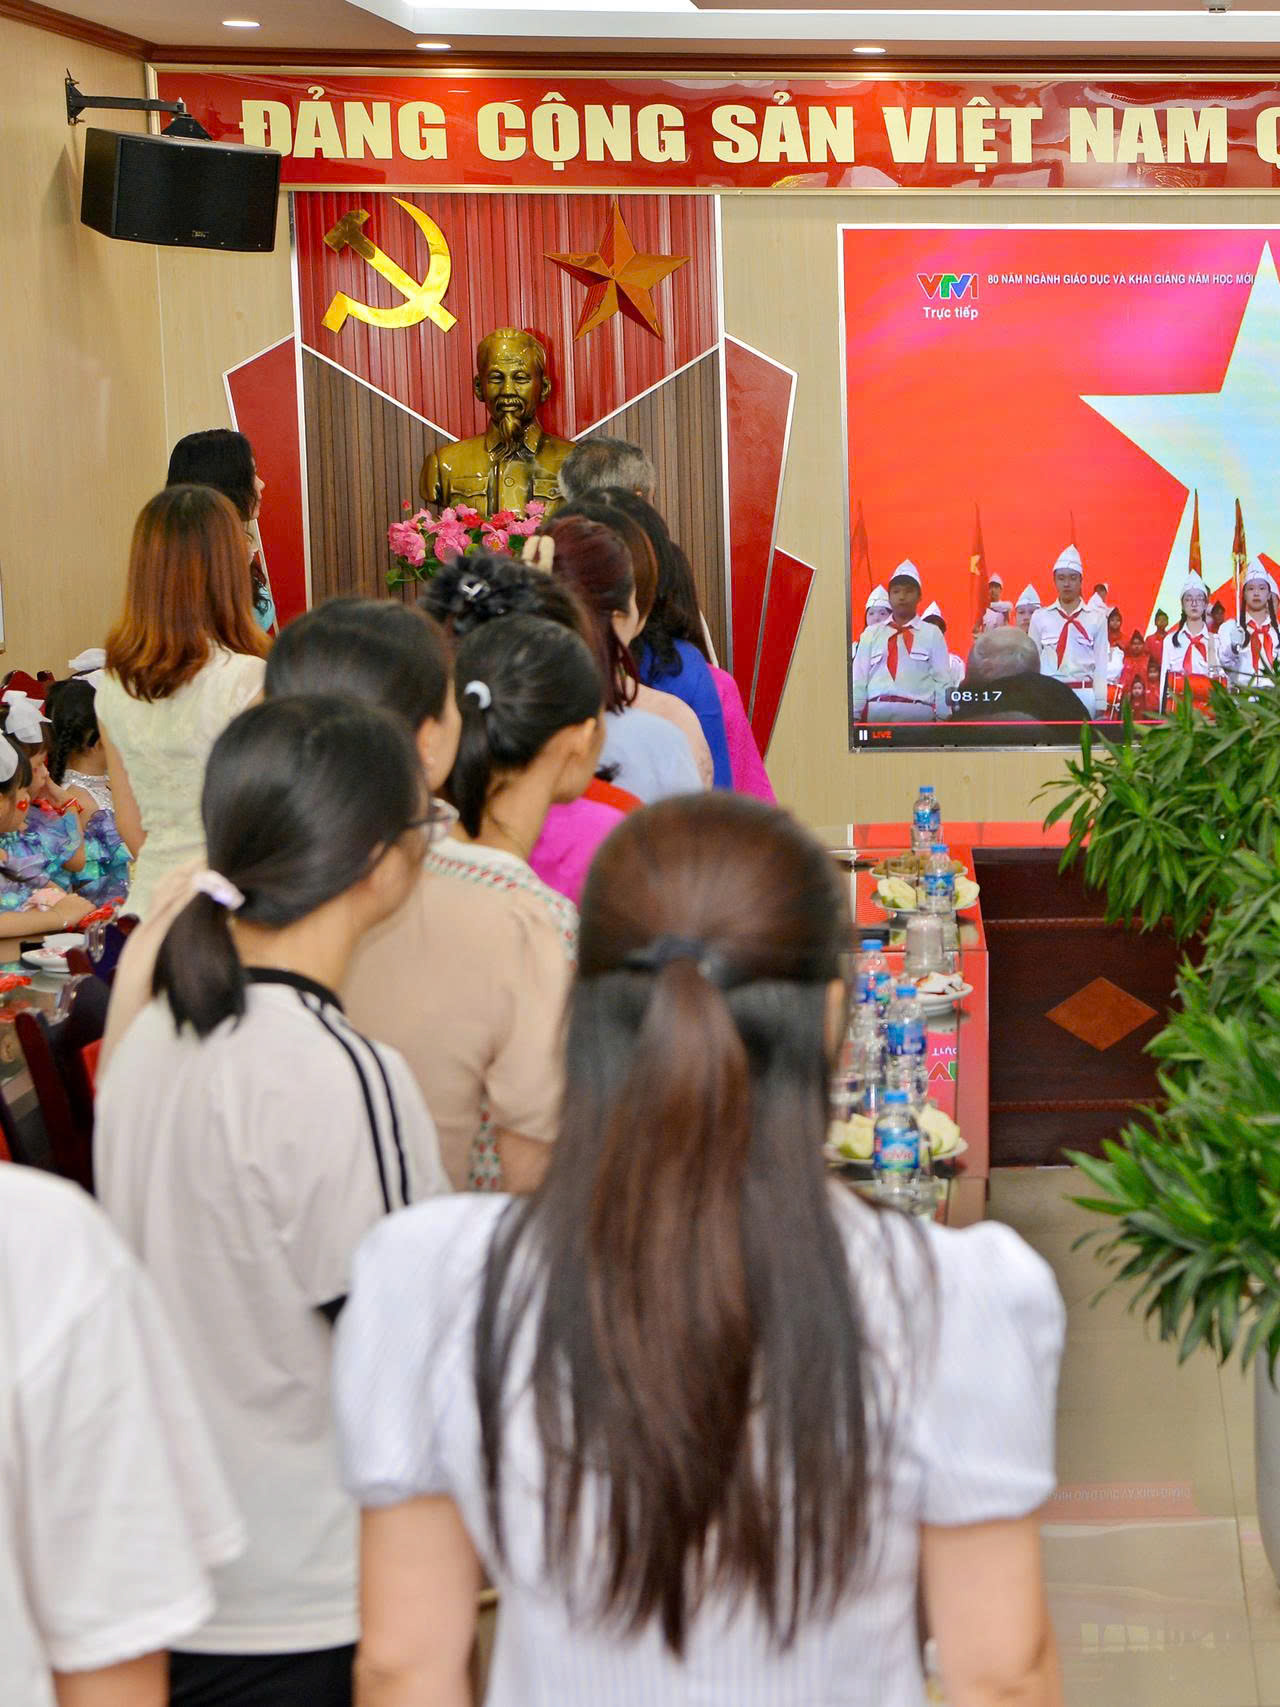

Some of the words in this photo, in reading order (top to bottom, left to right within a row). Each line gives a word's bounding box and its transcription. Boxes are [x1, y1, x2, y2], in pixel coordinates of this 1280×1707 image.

[239, 86, 447, 160] ĐẢNG
[477, 91, 686, 171] CỘNG
[712, 91, 855, 164] SẢN
[882, 96, 1043, 173] VIỆT
[1069, 106, 1228, 164] NAM
[917, 272, 979, 299] VTV1
[987, 274, 999, 285] 80
[1025, 272, 1060, 285] NGÀNH
[1063, 271, 1088, 285] GIÁO
[1090, 273, 1111, 286] DỤC
[1113, 271, 1126, 285] VÀ
[1128, 273, 1152, 285] KHAI
[1212, 273, 1233, 286] HỌC
[923, 306, 951, 320] Trực
[954, 304, 979, 320] tiếp
[951, 690, 1002, 702] 08:17
[872, 730, 892, 739] LIVE
